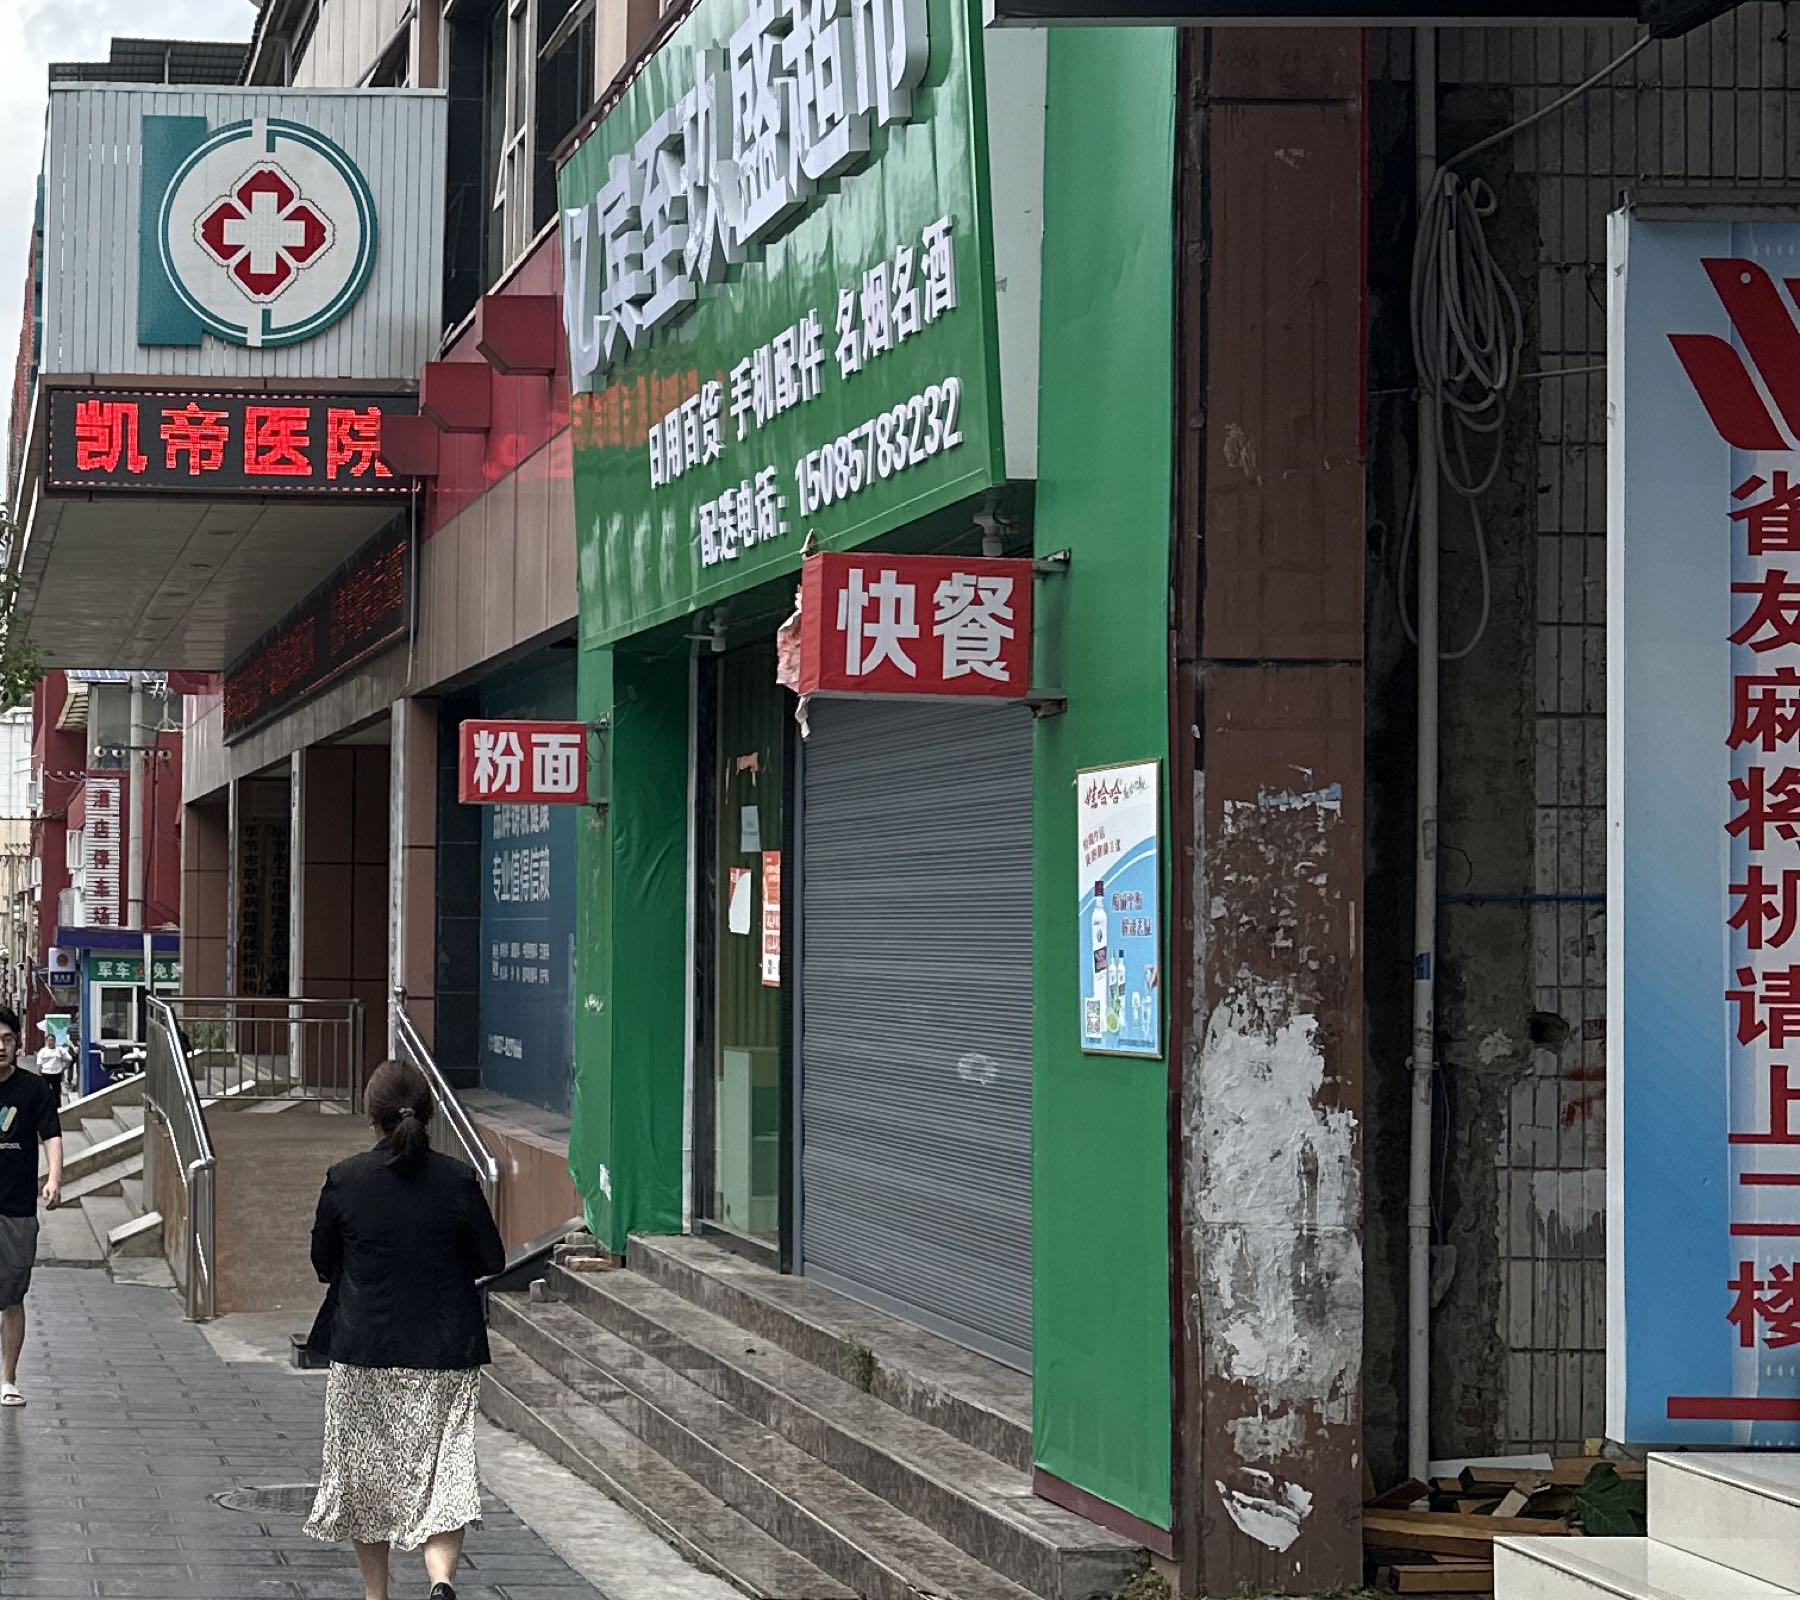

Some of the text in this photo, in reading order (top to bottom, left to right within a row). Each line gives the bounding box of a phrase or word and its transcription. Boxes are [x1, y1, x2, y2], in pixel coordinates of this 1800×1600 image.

[649, 215, 957, 490] 日用百货 手机配件 名烟名酒
[74, 399, 394, 480] 凯帝医院
[795, 376, 963, 517] 15085783232
[837, 568, 1015, 683] 快餐
[473, 730, 581, 795] 粉面
[1725, 468, 1800, 1350] 雀友麻将机请上二楼
[98, 961, 130, 978] 军车
